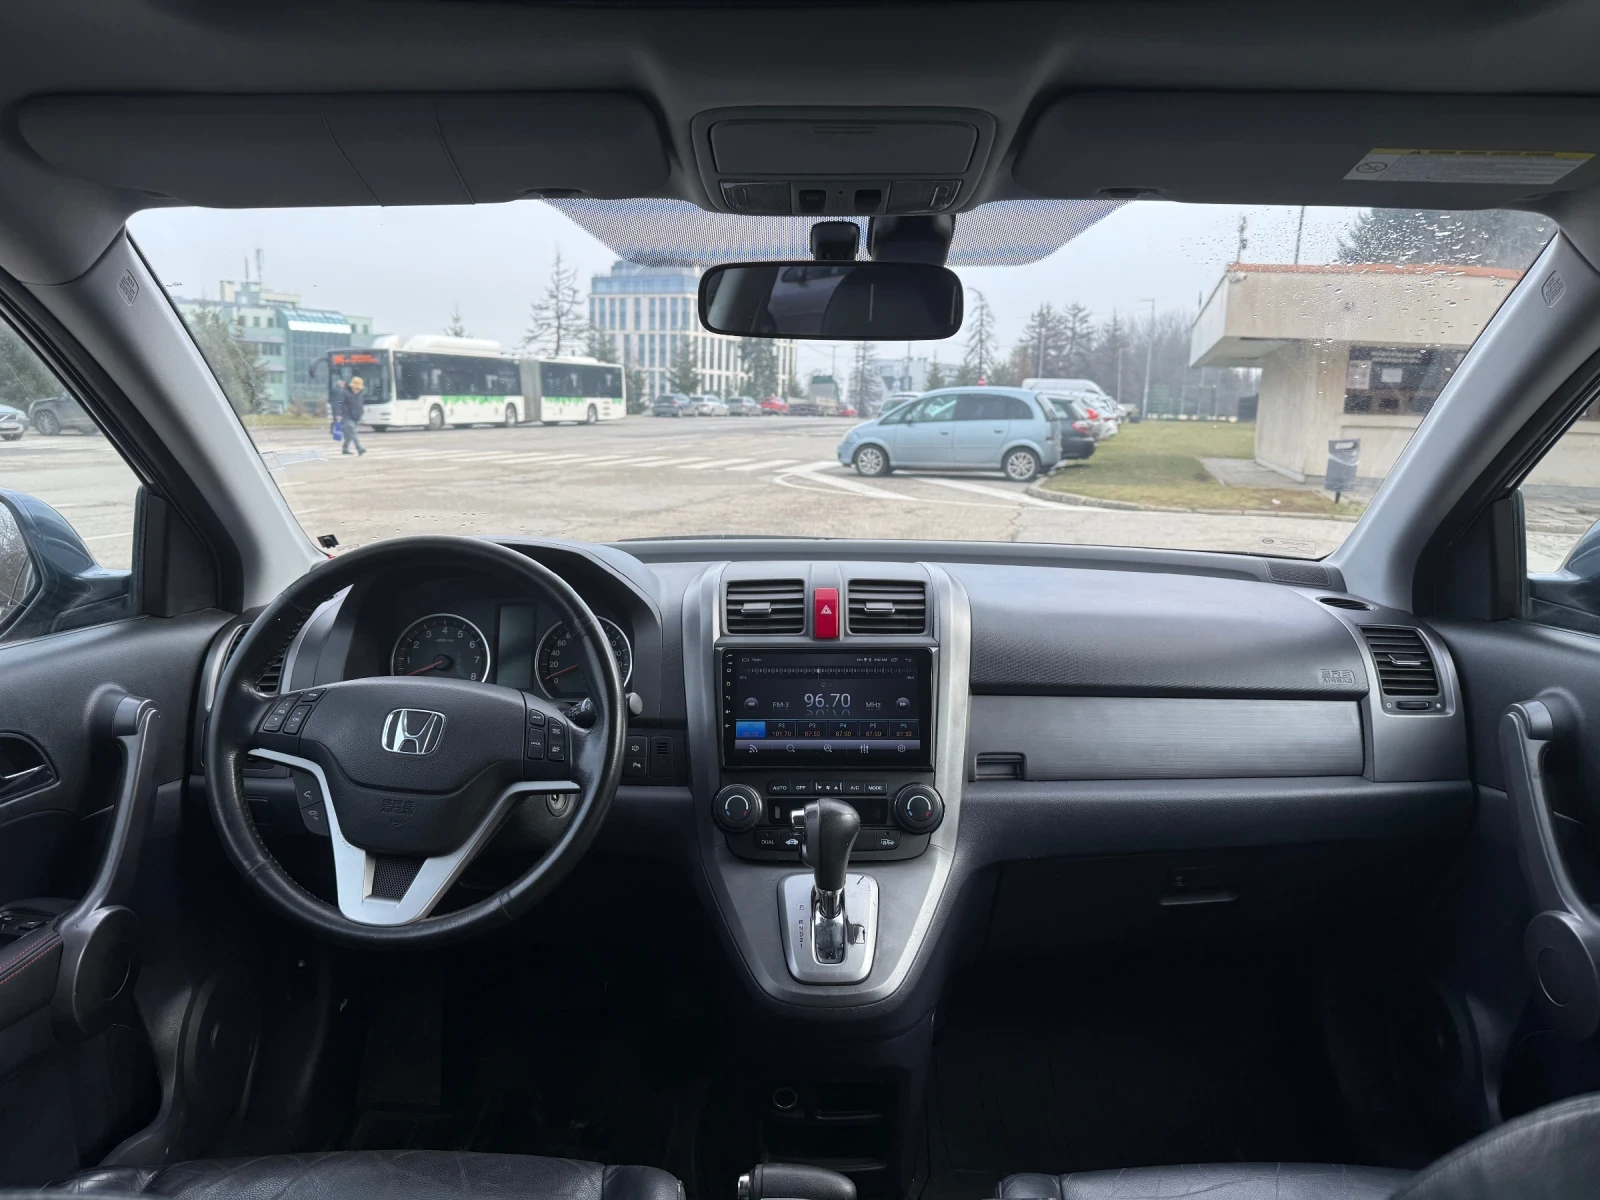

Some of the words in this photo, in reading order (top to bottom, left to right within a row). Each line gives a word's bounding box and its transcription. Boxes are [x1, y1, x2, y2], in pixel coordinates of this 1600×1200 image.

[425, 630, 432, 638] 3
[442, 626, 448, 634] 4
[457, 630, 464, 638] 5
[413, 641, 420, 649] 2
[469, 640, 476, 648] 6
[474, 656, 480, 664] 7
[804, 693, 851, 708] 96.70
